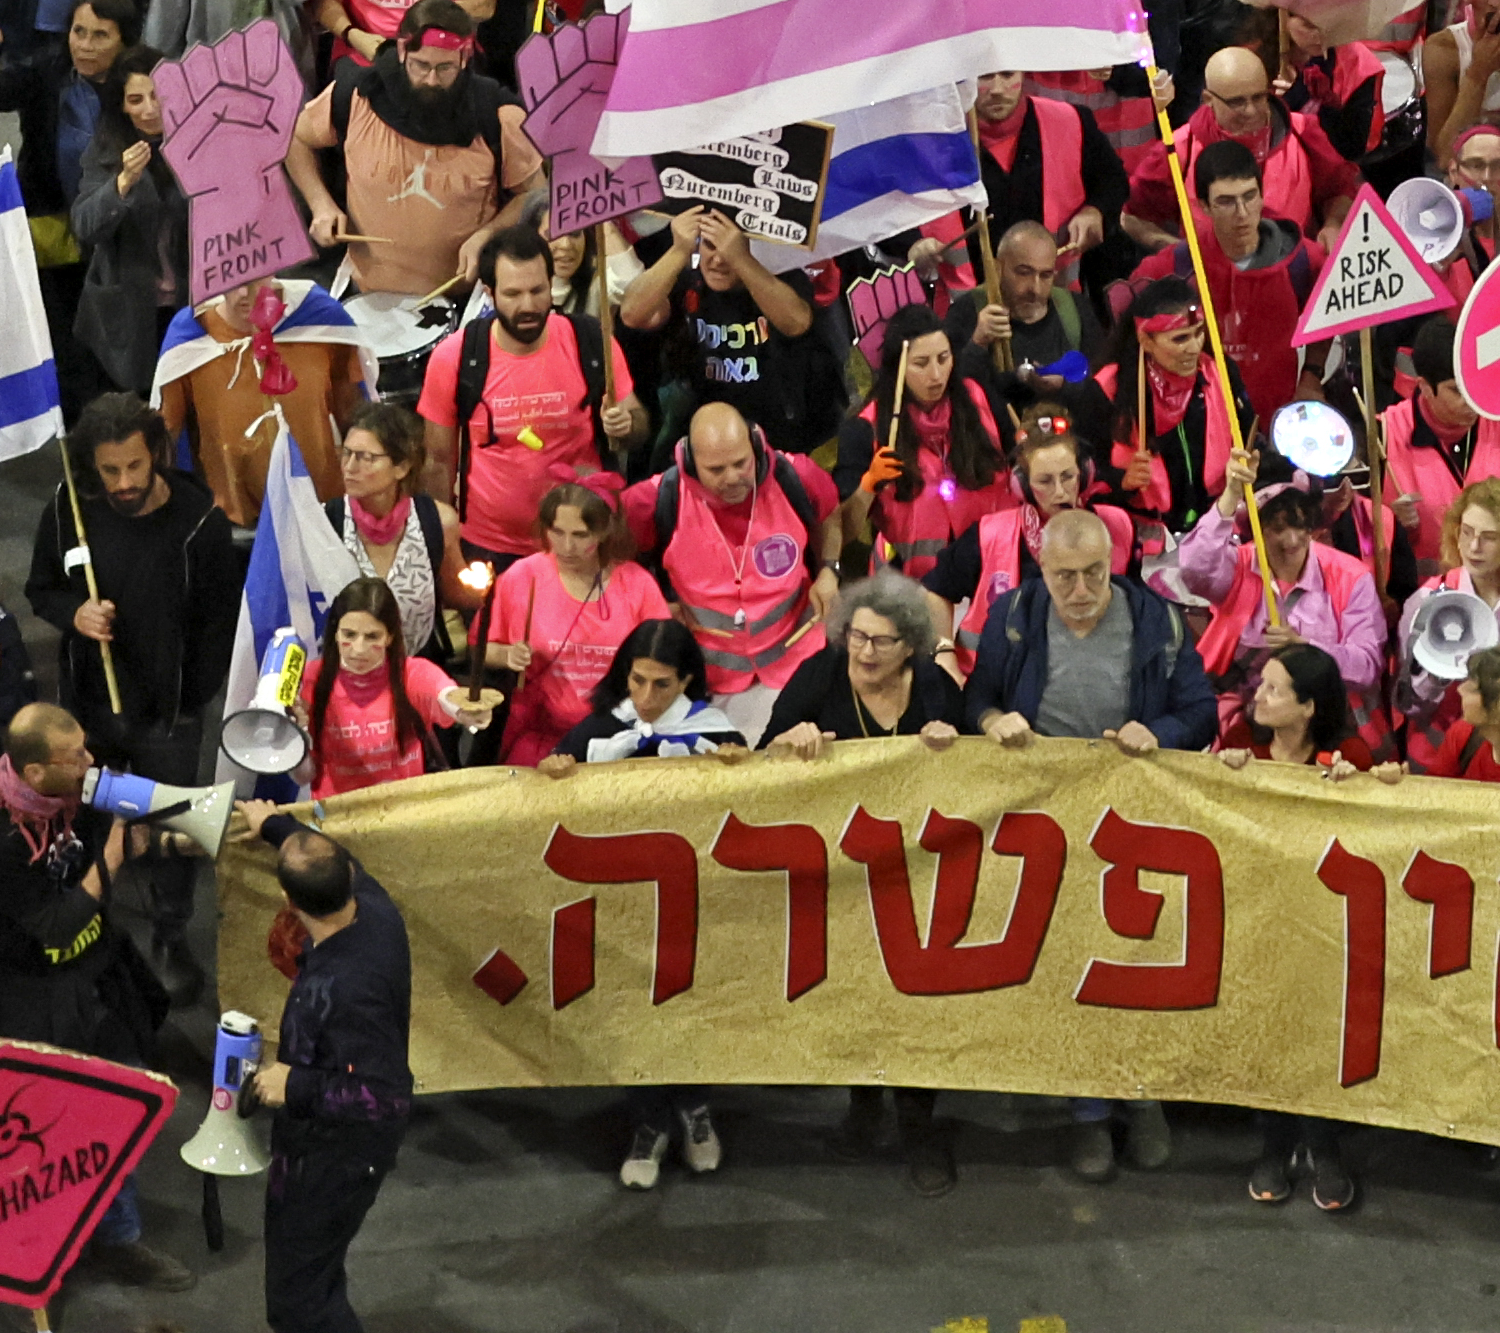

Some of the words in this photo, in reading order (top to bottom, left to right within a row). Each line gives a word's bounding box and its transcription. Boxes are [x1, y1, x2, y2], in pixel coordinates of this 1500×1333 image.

[556, 167, 624, 207] PINK
[557, 178, 650, 229] FRONT
[663, 173, 776, 213] Nuremberg
[759, 169, 816, 200] Laws
[202, 220, 260, 263] PINK
[741, 211, 804, 241] Trials
[203, 236, 286, 292] FRONT
[1339, 246, 1392, 282] RISK
[1324, 272, 1405, 314] AHEAD
[476, 805, 1224, 1013] פשרה.
